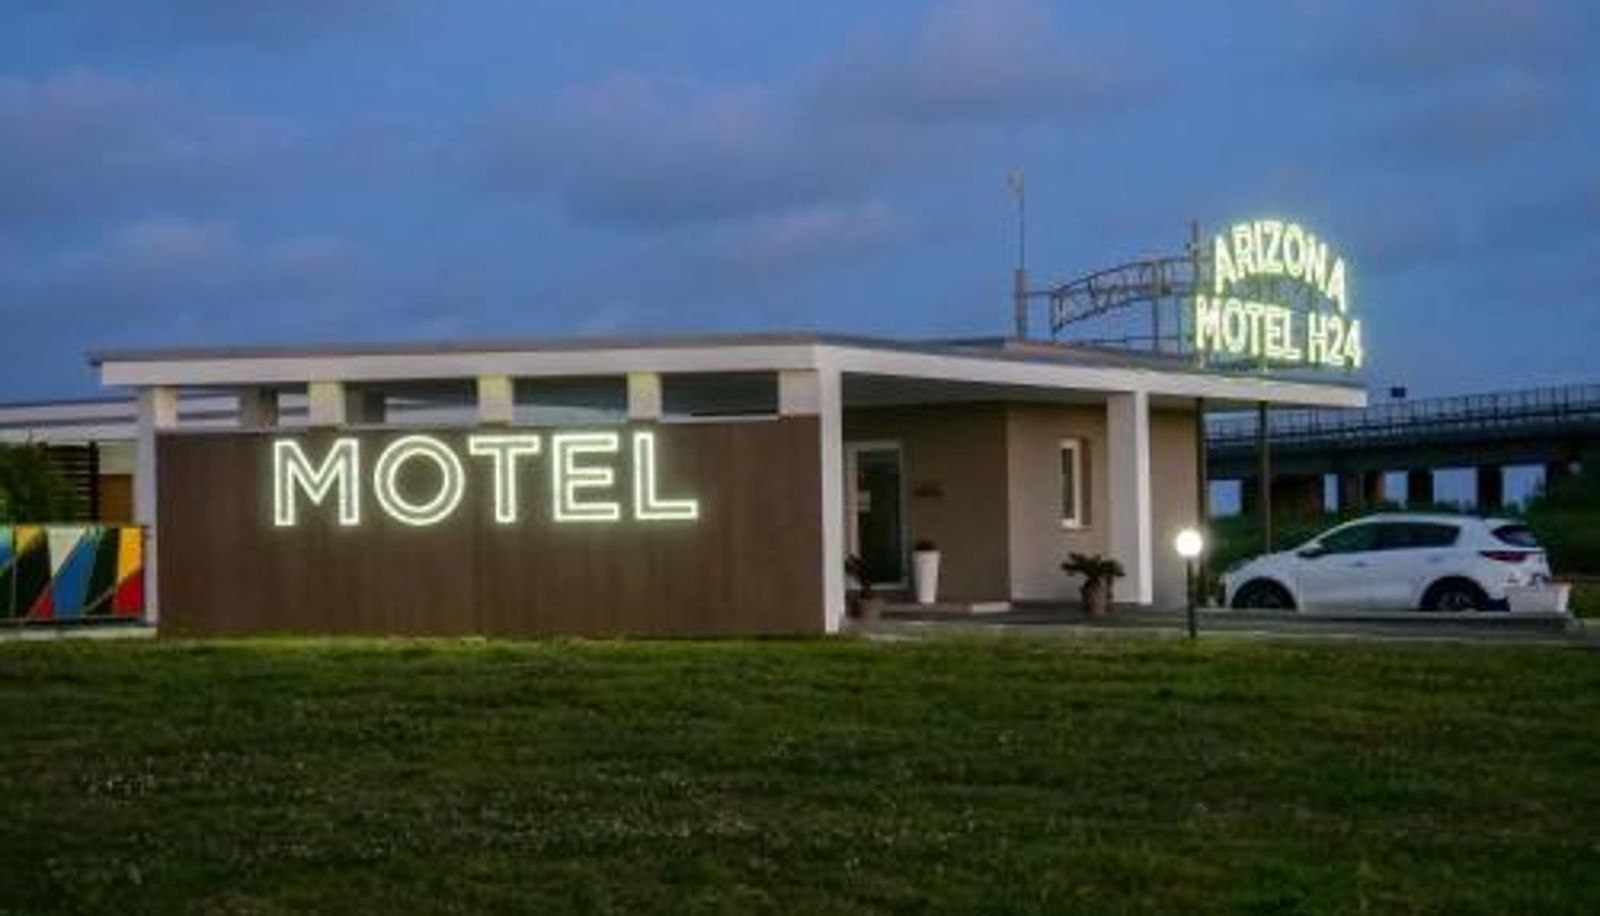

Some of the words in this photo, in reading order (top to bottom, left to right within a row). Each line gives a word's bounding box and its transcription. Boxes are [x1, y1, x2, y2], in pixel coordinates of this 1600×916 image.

[1214, 219, 1347, 311] ARIZONA
[1196, 294, 1301, 360] MOTEL
[1308, 312, 1362, 368] H24
[273, 431, 699, 527] MOTEL
